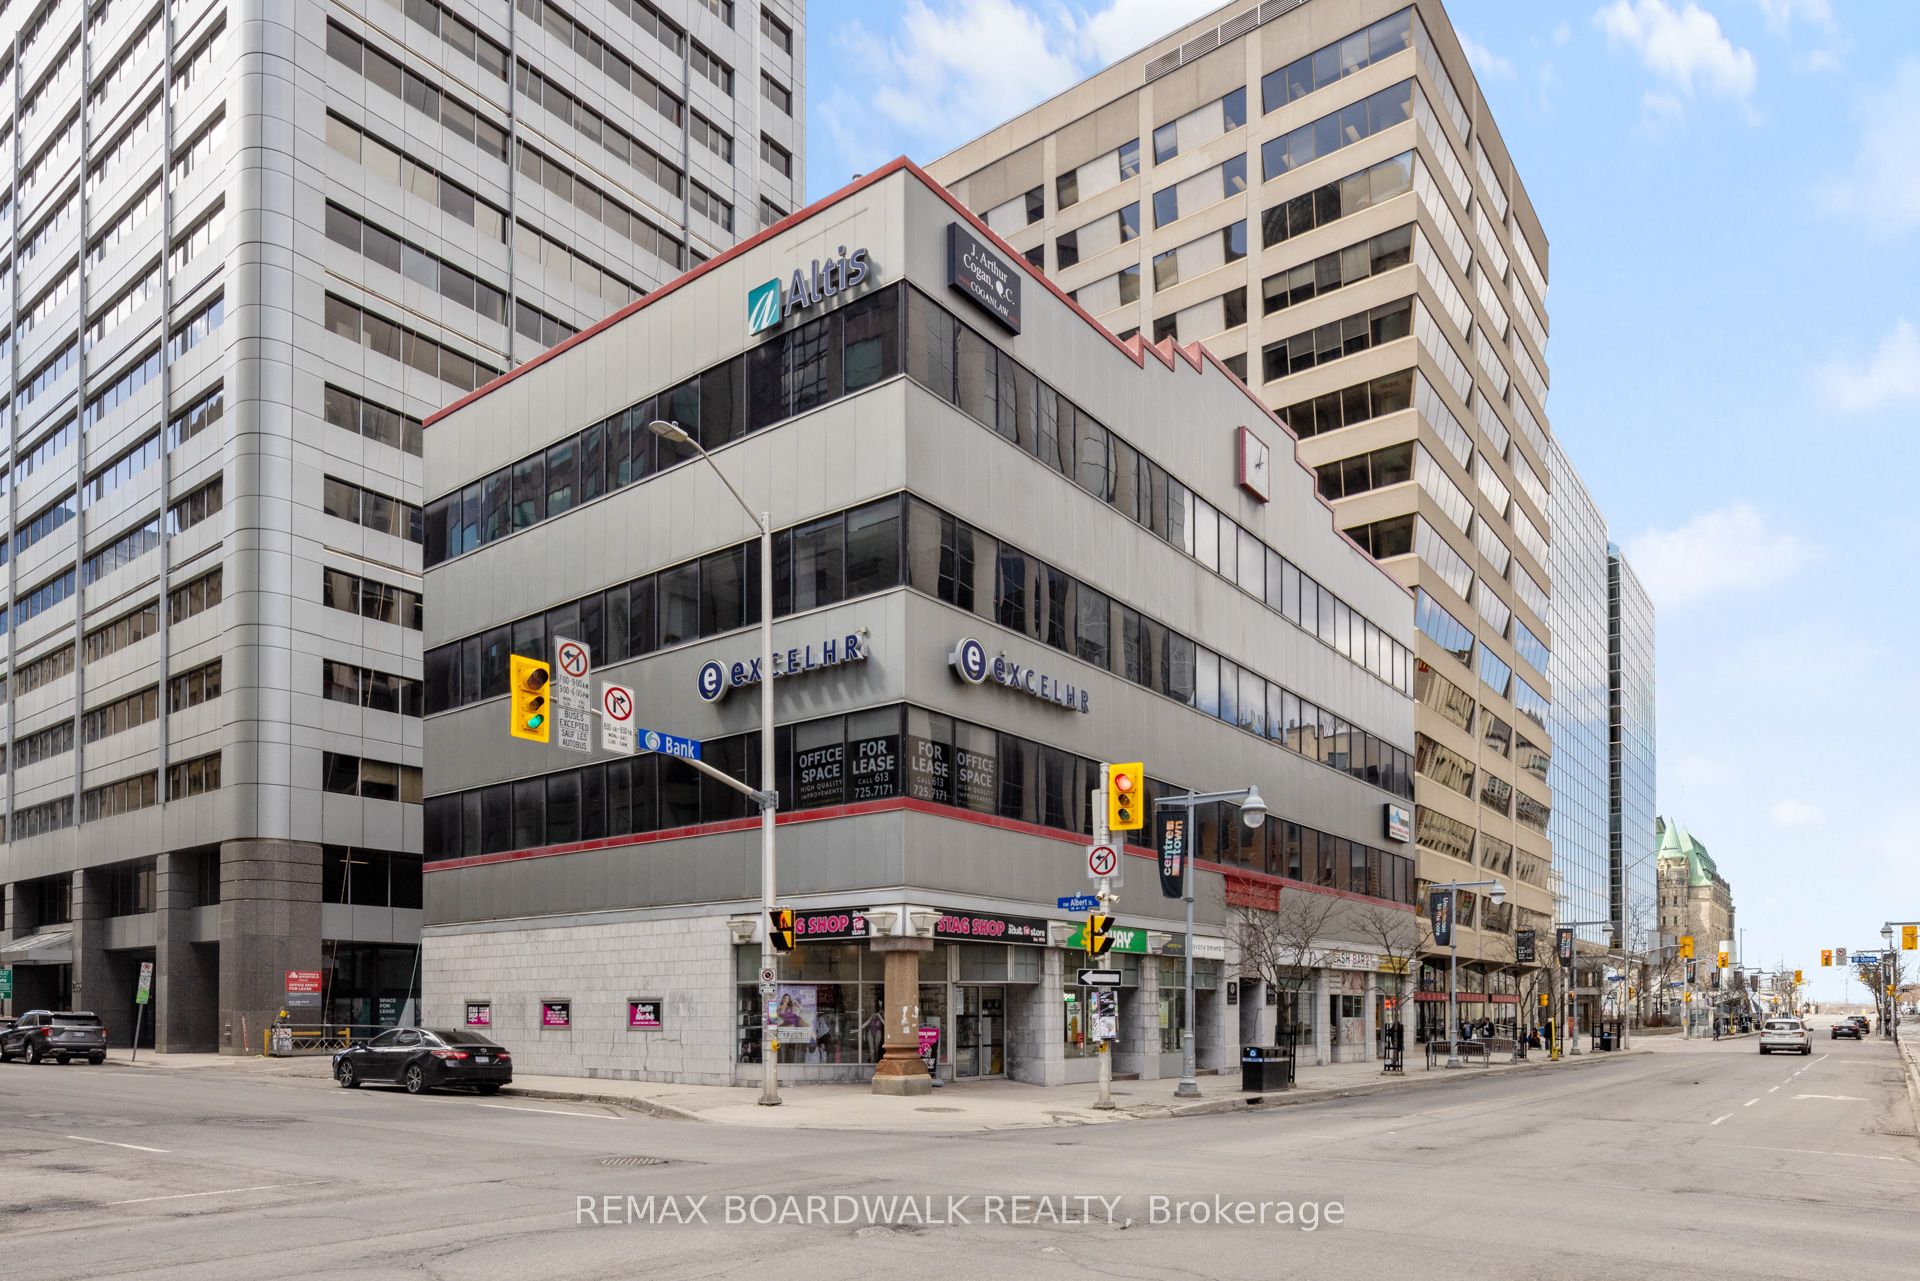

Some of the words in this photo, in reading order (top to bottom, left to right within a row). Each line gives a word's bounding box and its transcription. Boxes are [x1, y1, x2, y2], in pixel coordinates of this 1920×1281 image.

[963, 253, 994, 290] Cogan,
[980, 252, 1008, 283] Arthur
[785, 245, 868, 317] Altis
[560, 718, 589, 732] EXCEPTED
[564, 709, 584, 722] BUSES
[561, 728, 575, 739] SAUF
[577, 731, 588, 742] LES
[562, 738, 587, 750] AUTOBUS
[665, 736, 695, 759] Bank
[859, 740, 887, 758] FOR
[918, 741, 943, 760] FOR
[799, 747, 843, 768] OFFICE
[852, 755, 895, 775] LEASE
[912, 756, 948, 777] LEASE
[957, 752, 994, 773] OFFICE
[801, 764, 841, 783] SPACE
[857, 777, 873, 785] CALL
[874, 772, 889, 783] 613
[917, 777, 931, 785] CALL
[932, 777, 944, 788] 613
[959, 768, 992, 788] SPACE
[800, 784, 815, 793] HIGH
[816, 780, 843, 790] QUALITY
[800, 787, 843, 800] IMPROVEMENTS
[854, 783, 893, 798] 725.7171
[913, 784, 947, 801] 725.7171
[957, 783, 972, 792] HIGH
[973, 786, 994, 797] QUALITY
[1173, 820, 1183, 855] town
[1163, 830, 1175, 876] centre
[1070, 898, 1088, 907] Albert
[808, 915, 849, 934] SHOP
[937, 916, 970, 934] STAG
[971, 918, 1006, 937] SHOP
